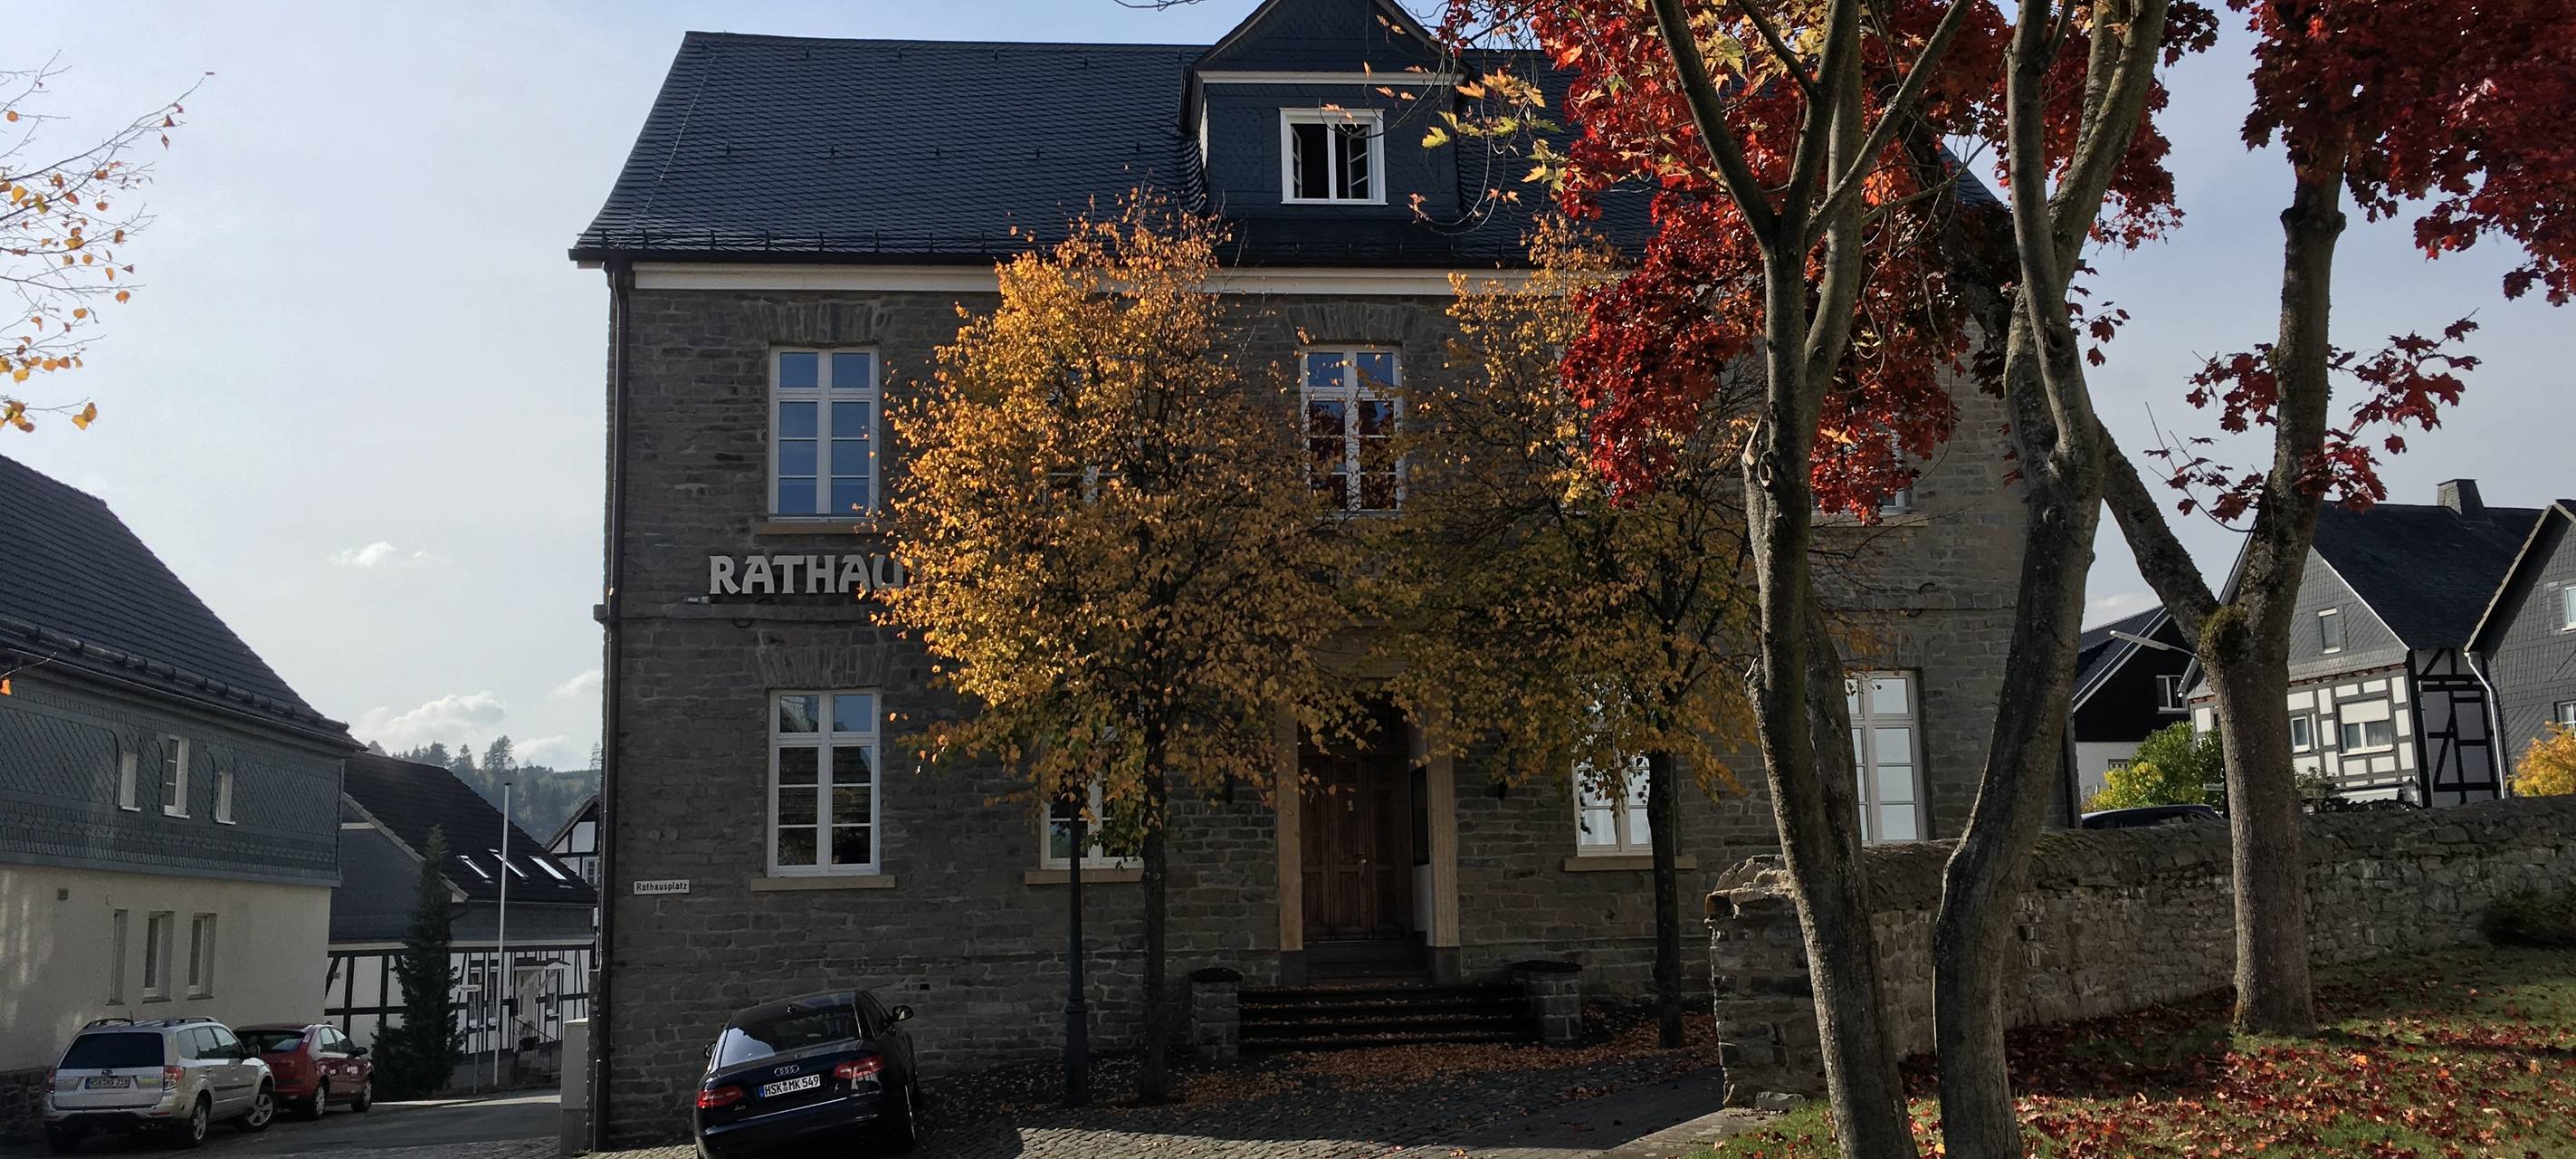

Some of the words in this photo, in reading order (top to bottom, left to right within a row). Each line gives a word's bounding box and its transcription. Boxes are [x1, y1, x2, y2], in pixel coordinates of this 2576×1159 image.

[710, 554, 921, 594] RATHAU
[636, 882, 688, 892] Rathausplatz
[765, 1083, 783, 1096] HSK
[788, 1078, 801, 1091] MK
[802, 1076, 819, 1087] 549
